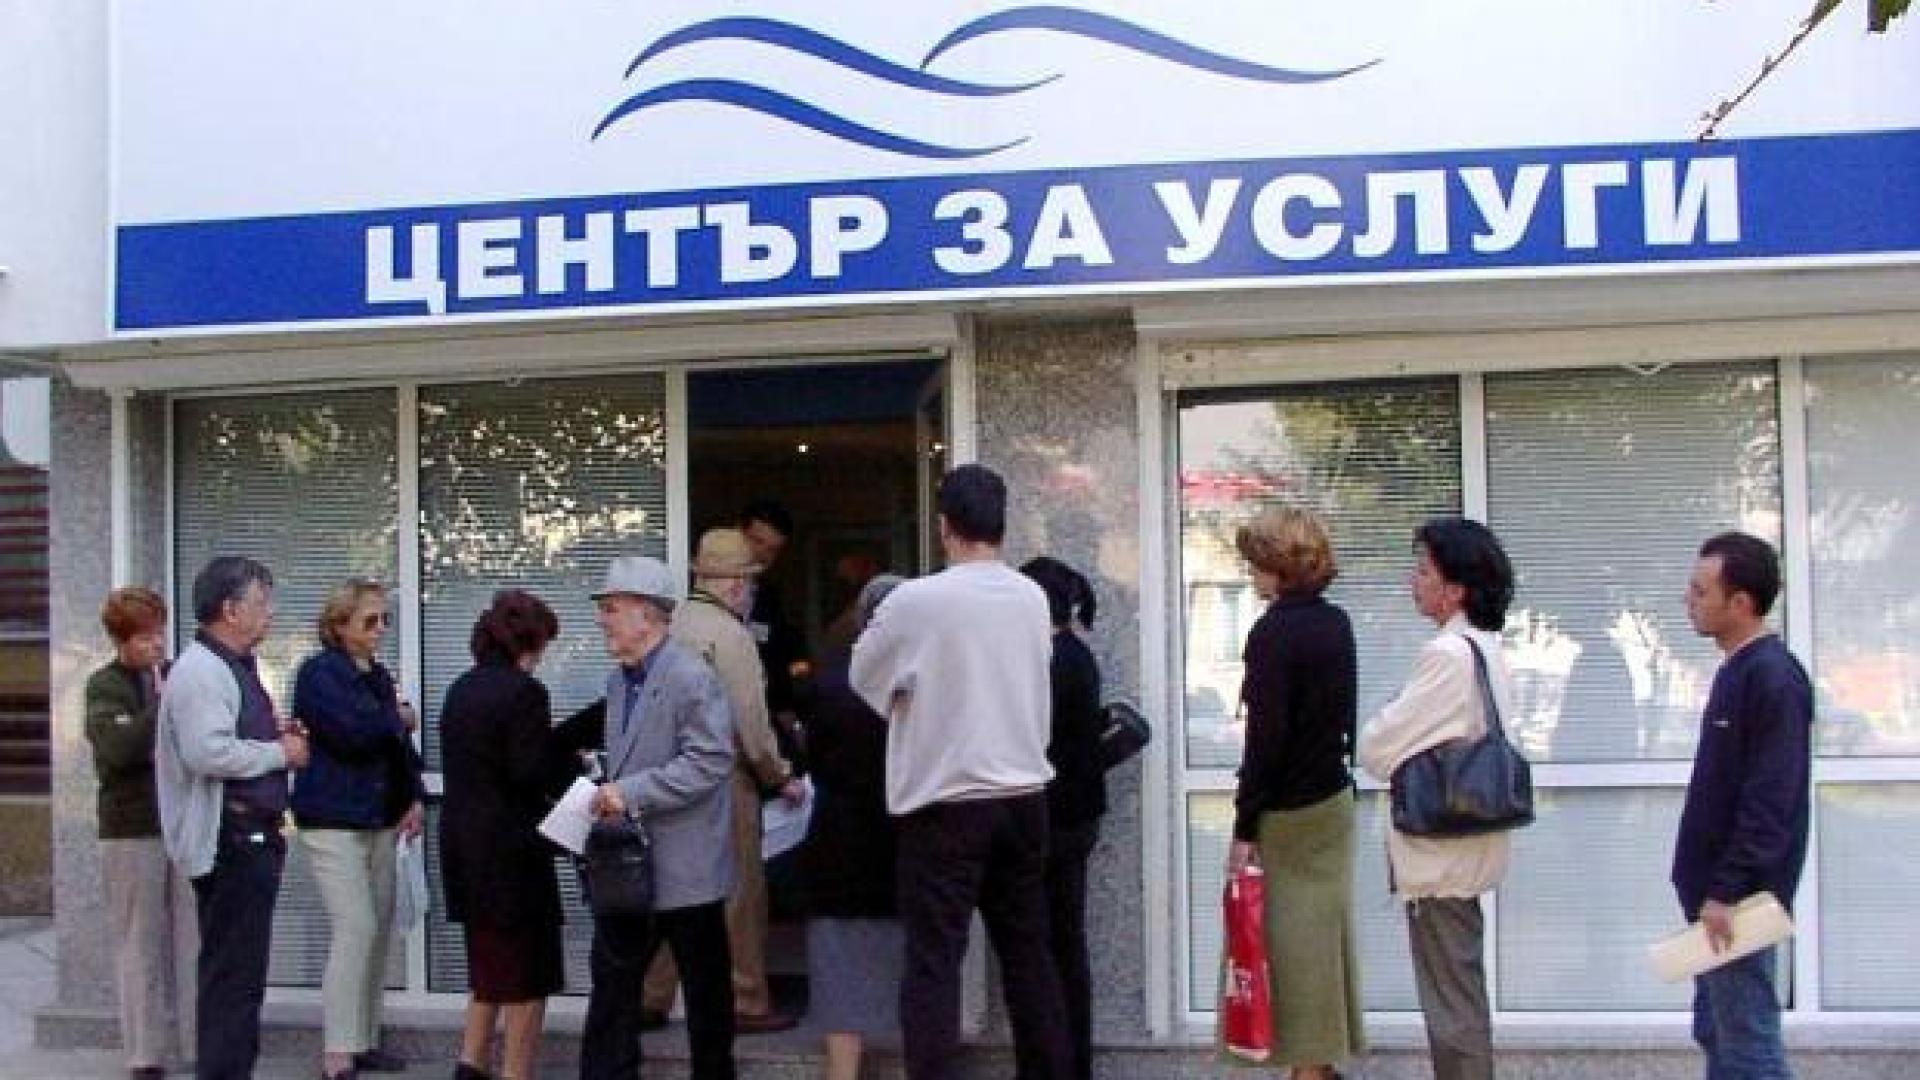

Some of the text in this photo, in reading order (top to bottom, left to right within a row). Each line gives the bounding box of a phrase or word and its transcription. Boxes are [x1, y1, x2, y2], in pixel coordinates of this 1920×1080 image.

[365, 156, 1740, 315] ЦЕНТЪР ЗА УСЛУГИ
